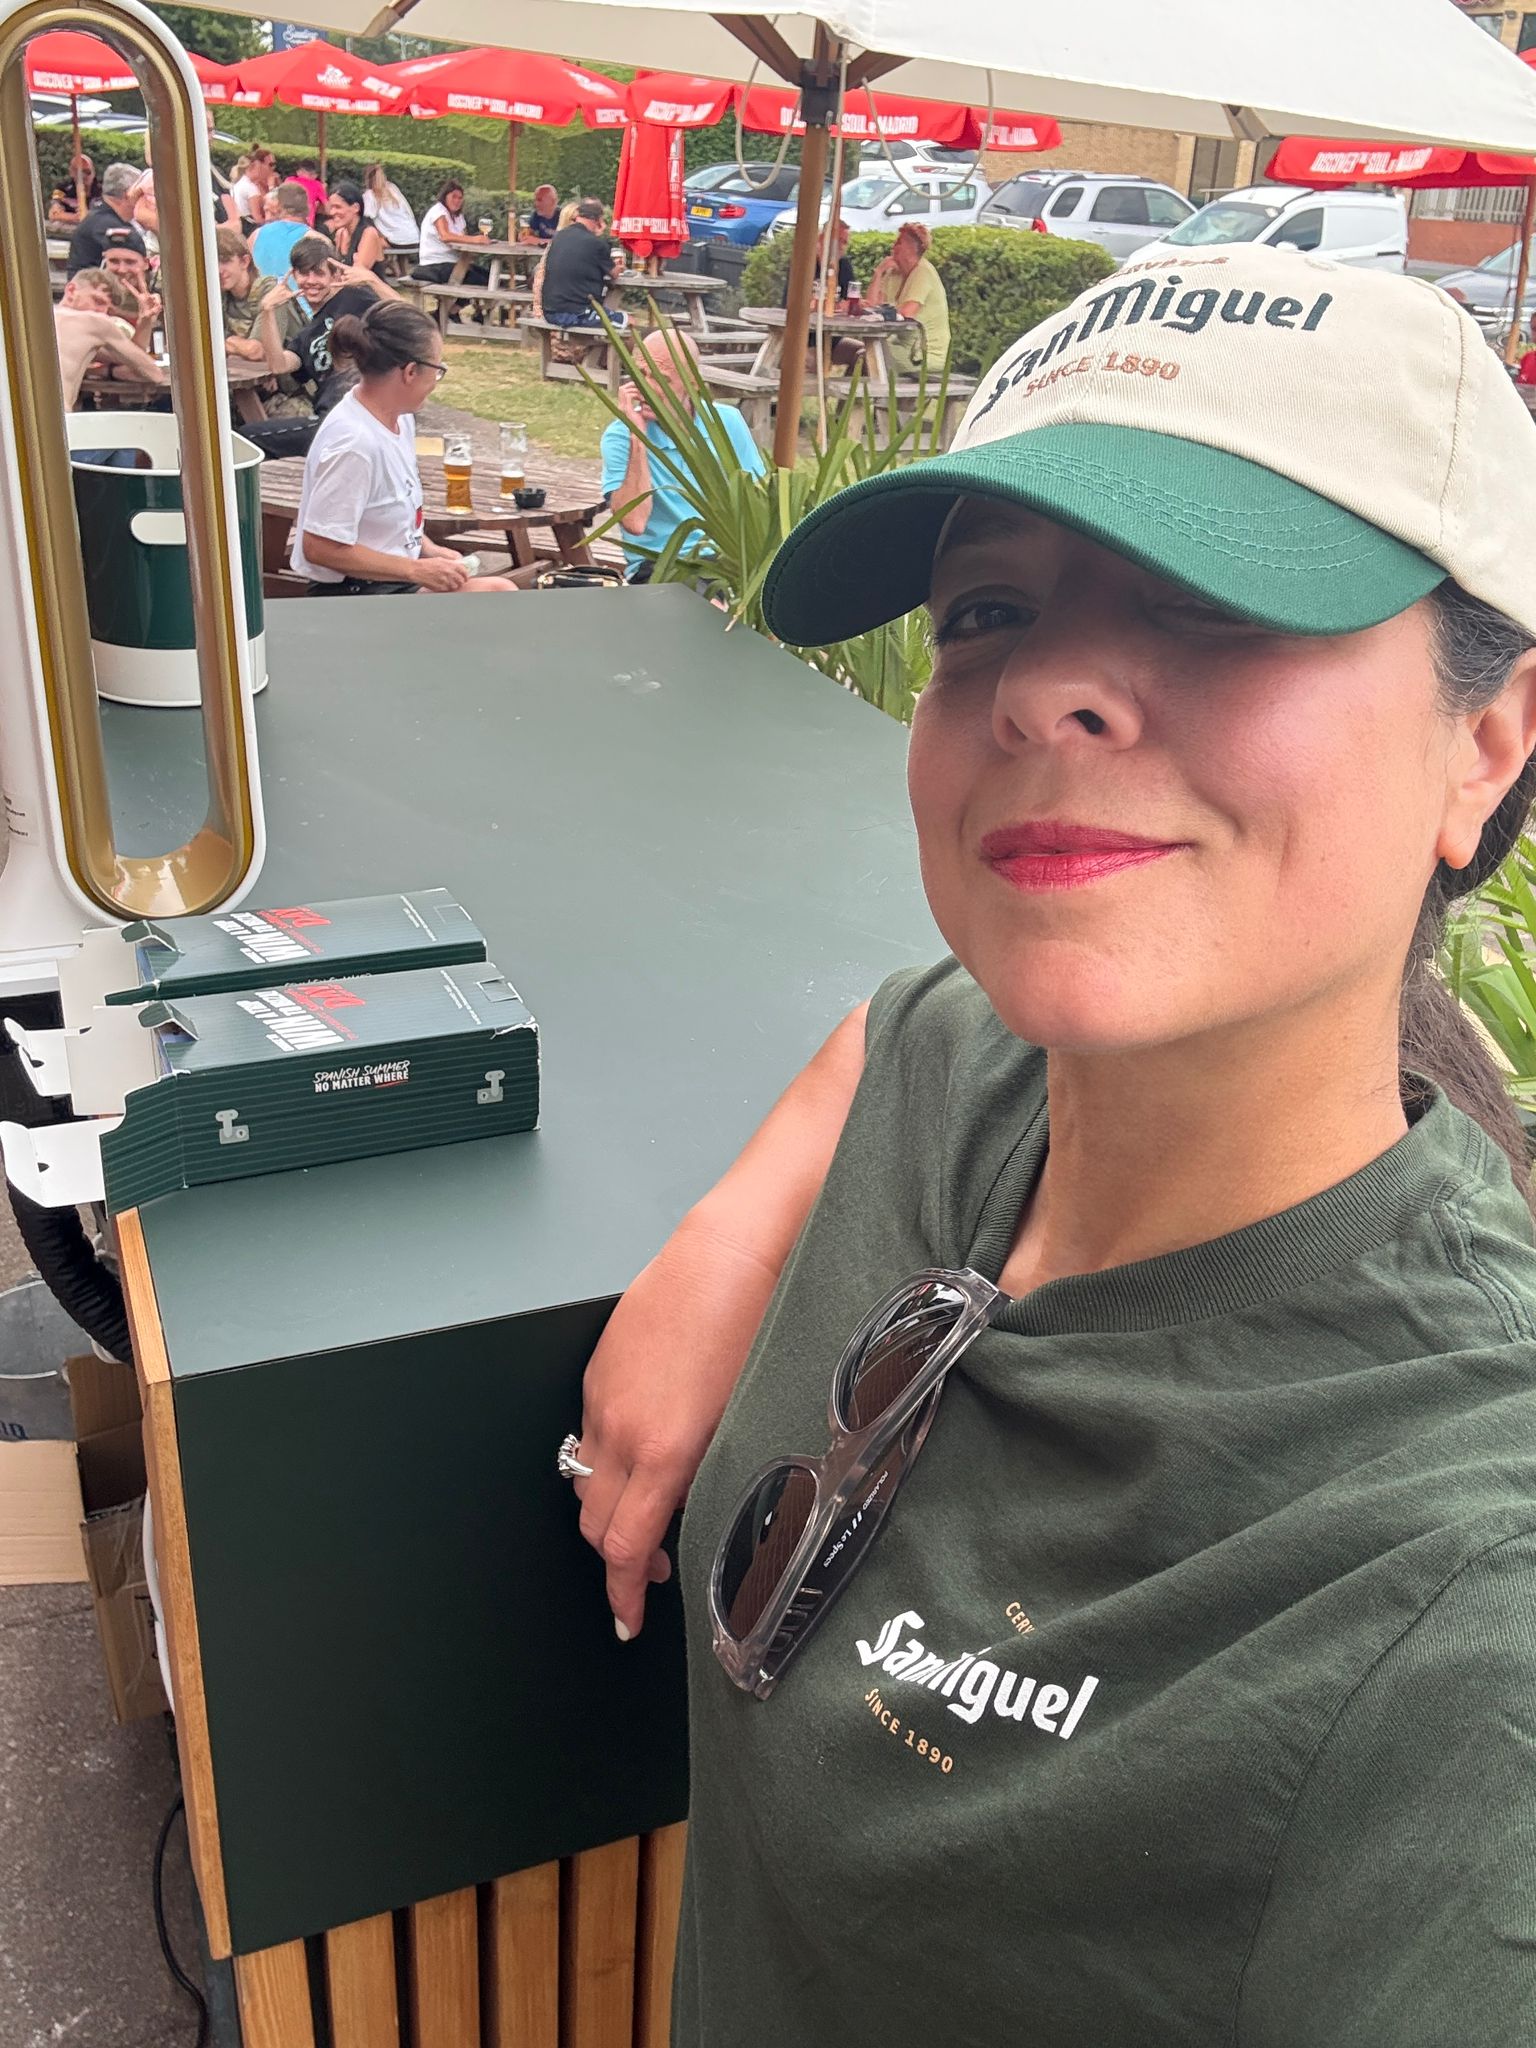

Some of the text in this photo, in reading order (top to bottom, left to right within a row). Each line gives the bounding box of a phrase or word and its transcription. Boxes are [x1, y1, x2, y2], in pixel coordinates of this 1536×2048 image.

[968, 275, 1333, 431] San Miguel
[1023, 351, 1181, 398] SINCE 1890
[313, 1060, 411, 1084] SPANISH SUMMER
[314, 1071, 409, 1093] NO MATTER WHERE
[822, 1541, 844, 1568] Specs
[864, 1687, 954, 1775] SINCE 1890
